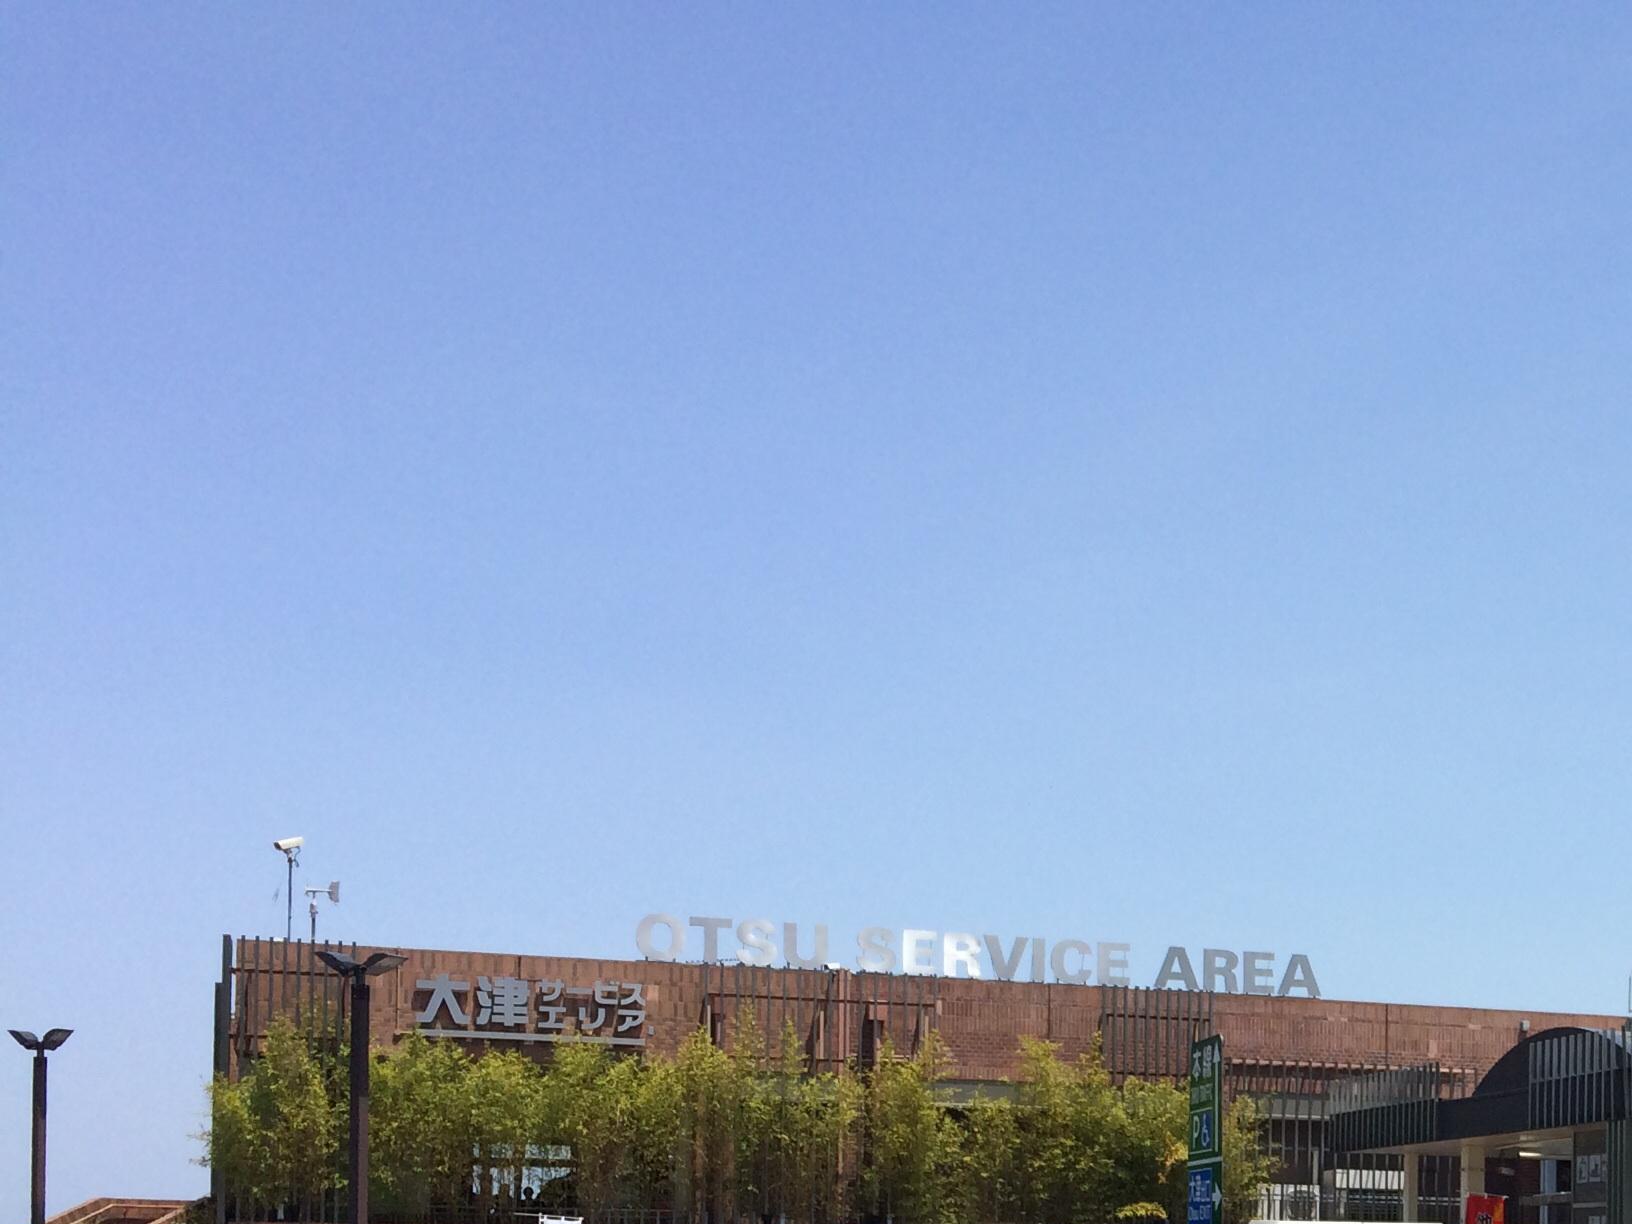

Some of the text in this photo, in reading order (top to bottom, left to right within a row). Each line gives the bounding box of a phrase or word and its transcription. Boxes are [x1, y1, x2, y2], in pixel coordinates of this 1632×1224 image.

[635, 913, 1322, 999] OTSU SERVICE AREA
[416, 974, 529, 1027] 大津
[536, 979, 645, 1006] サービス
[538, 1006, 646, 1032] エリア
[1192, 1116, 1200, 1149] P
